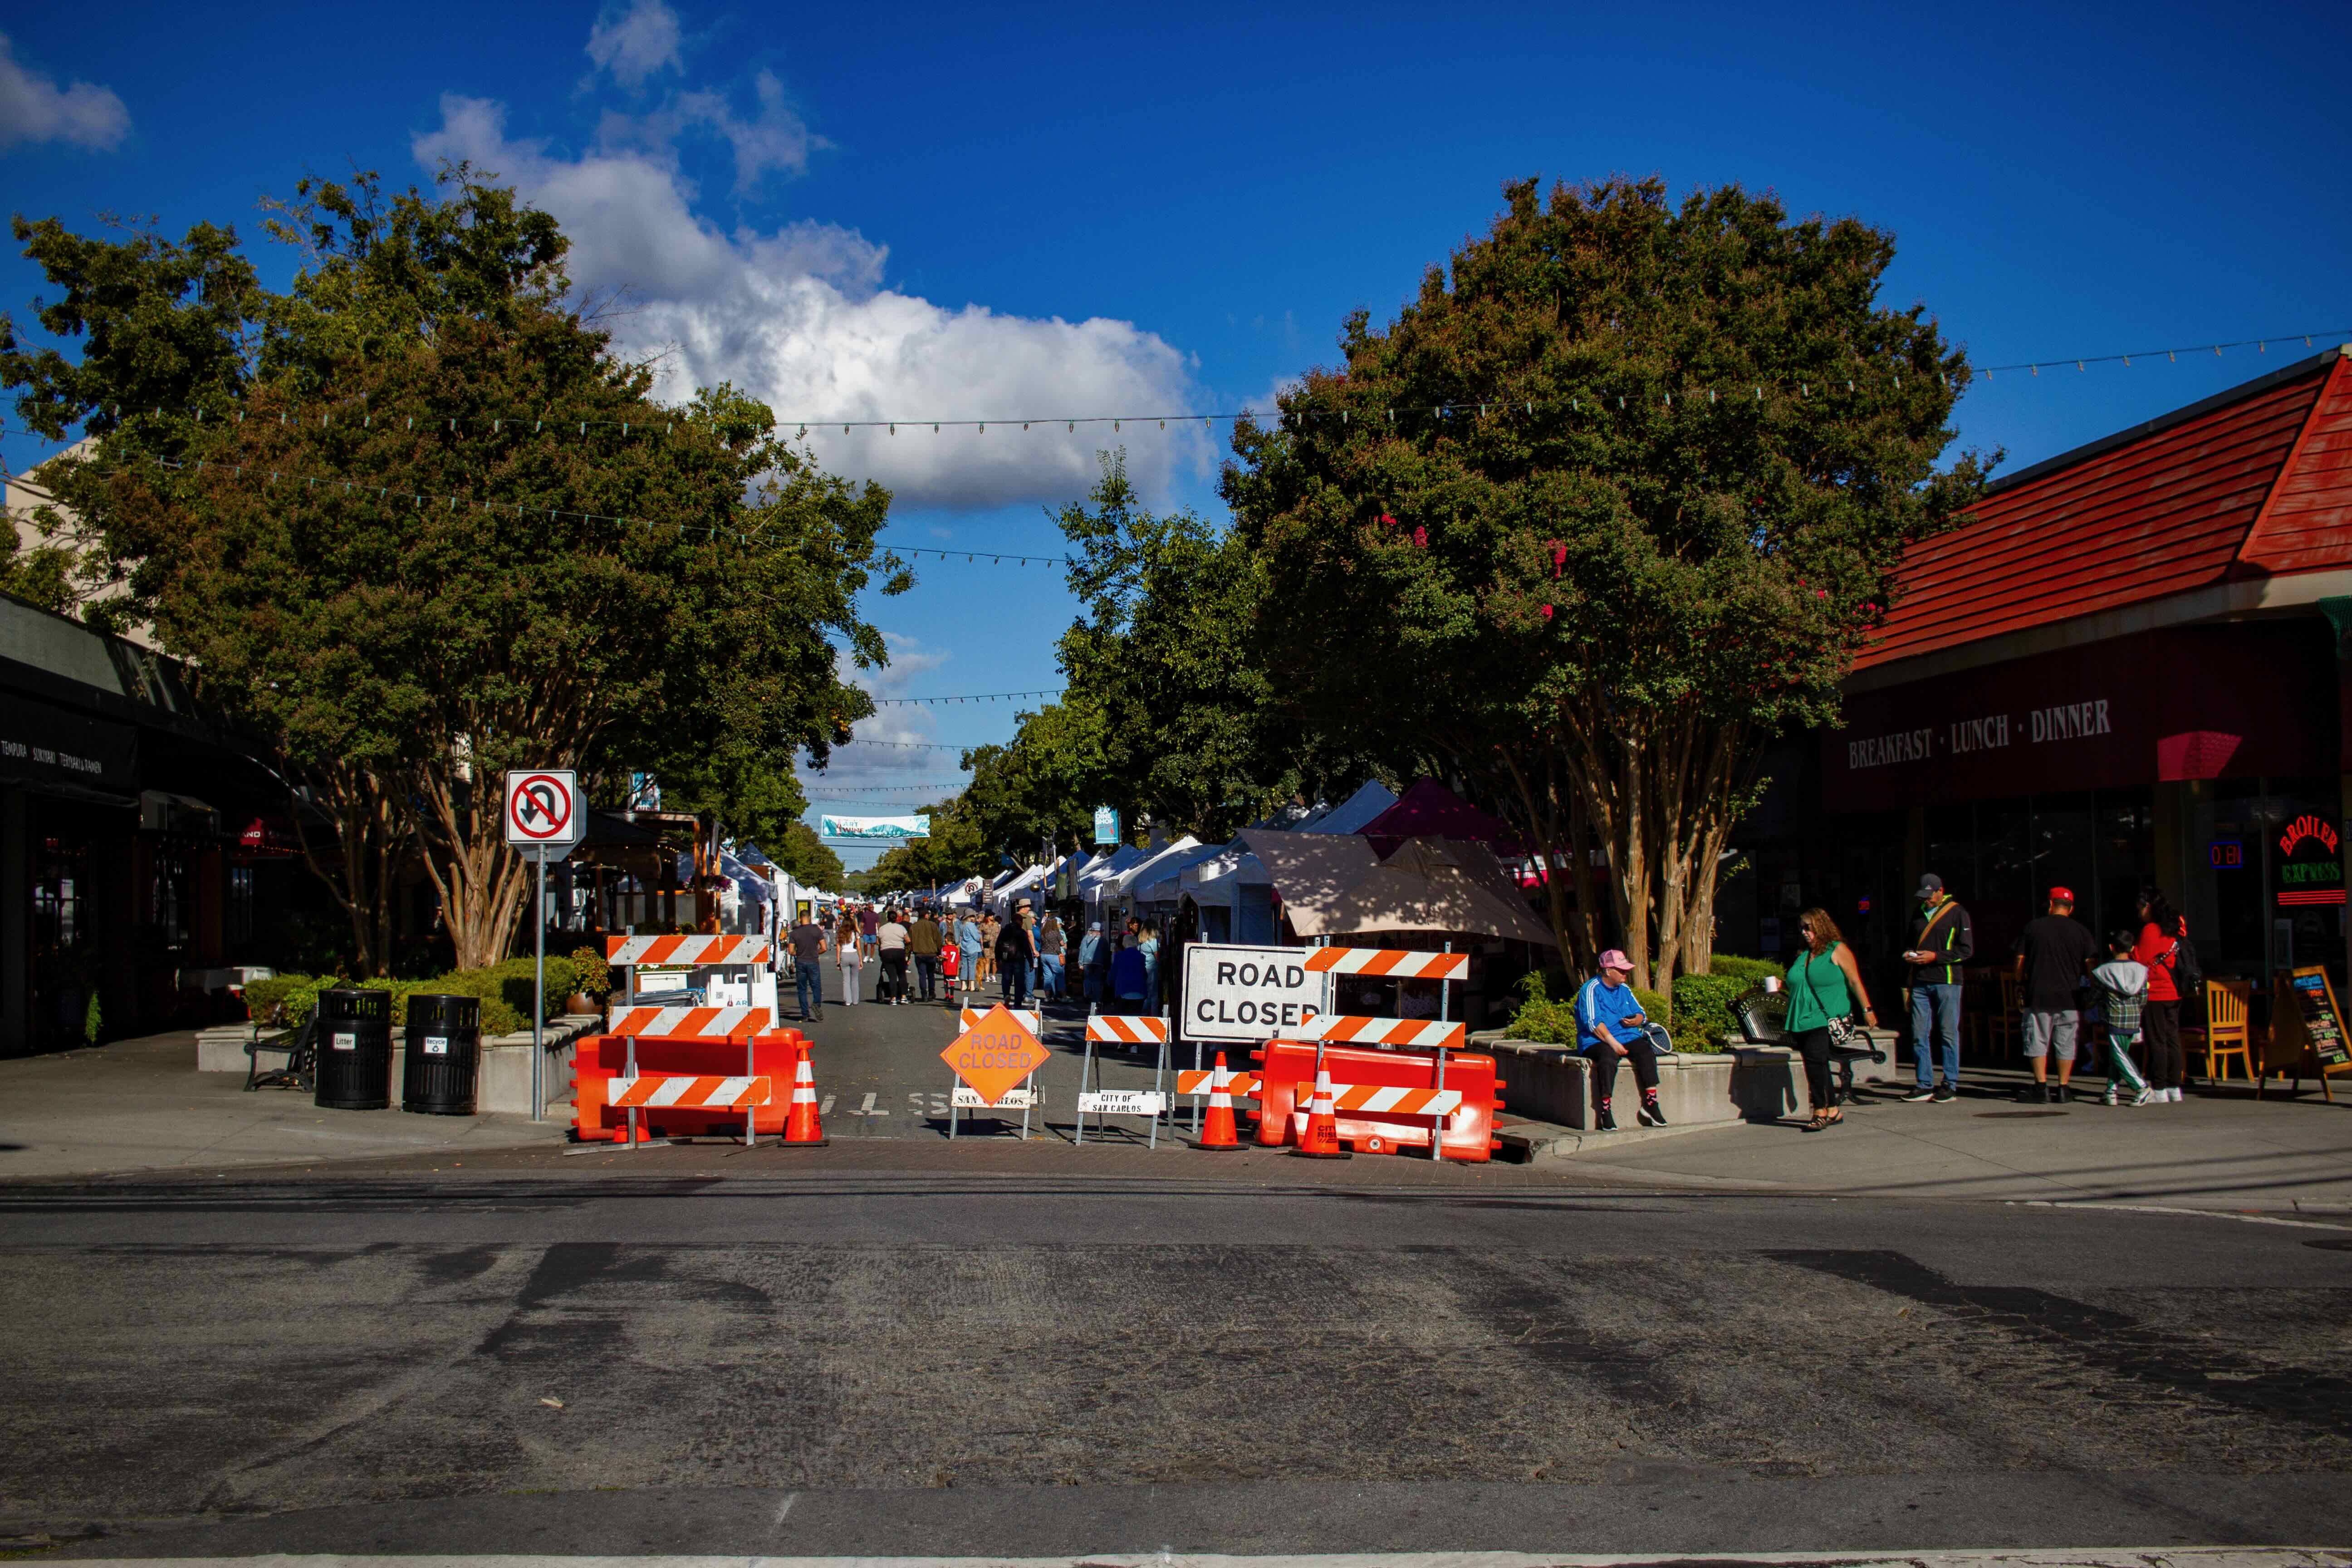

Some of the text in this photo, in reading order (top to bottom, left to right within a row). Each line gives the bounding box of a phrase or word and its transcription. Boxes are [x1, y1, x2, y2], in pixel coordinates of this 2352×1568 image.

[1848, 699, 2112, 770] BREAKFAST LUNCH DINNER
[0, 740, 28, 758] TEMPURA
[32, 747, 57, 764] SUKIYAKI
[59, 752, 80, 769] TERIYAKI
[85, 759, 102, 774] RAMEN
[2279, 815, 2338, 857] BROILER
[2212, 845, 2241, 864] OEN
[2282, 863, 2340, 883] EXPRESS
[950, 951, 956, 963] 7
[1218, 962, 1304, 988] ROAD
[970, 1034, 1022, 1050] ROAD
[959, 1052, 1031, 1068] CLOSED
[957, 1095, 978, 1104] SAN
[1101, 1094, 1119, 1102] CITY
